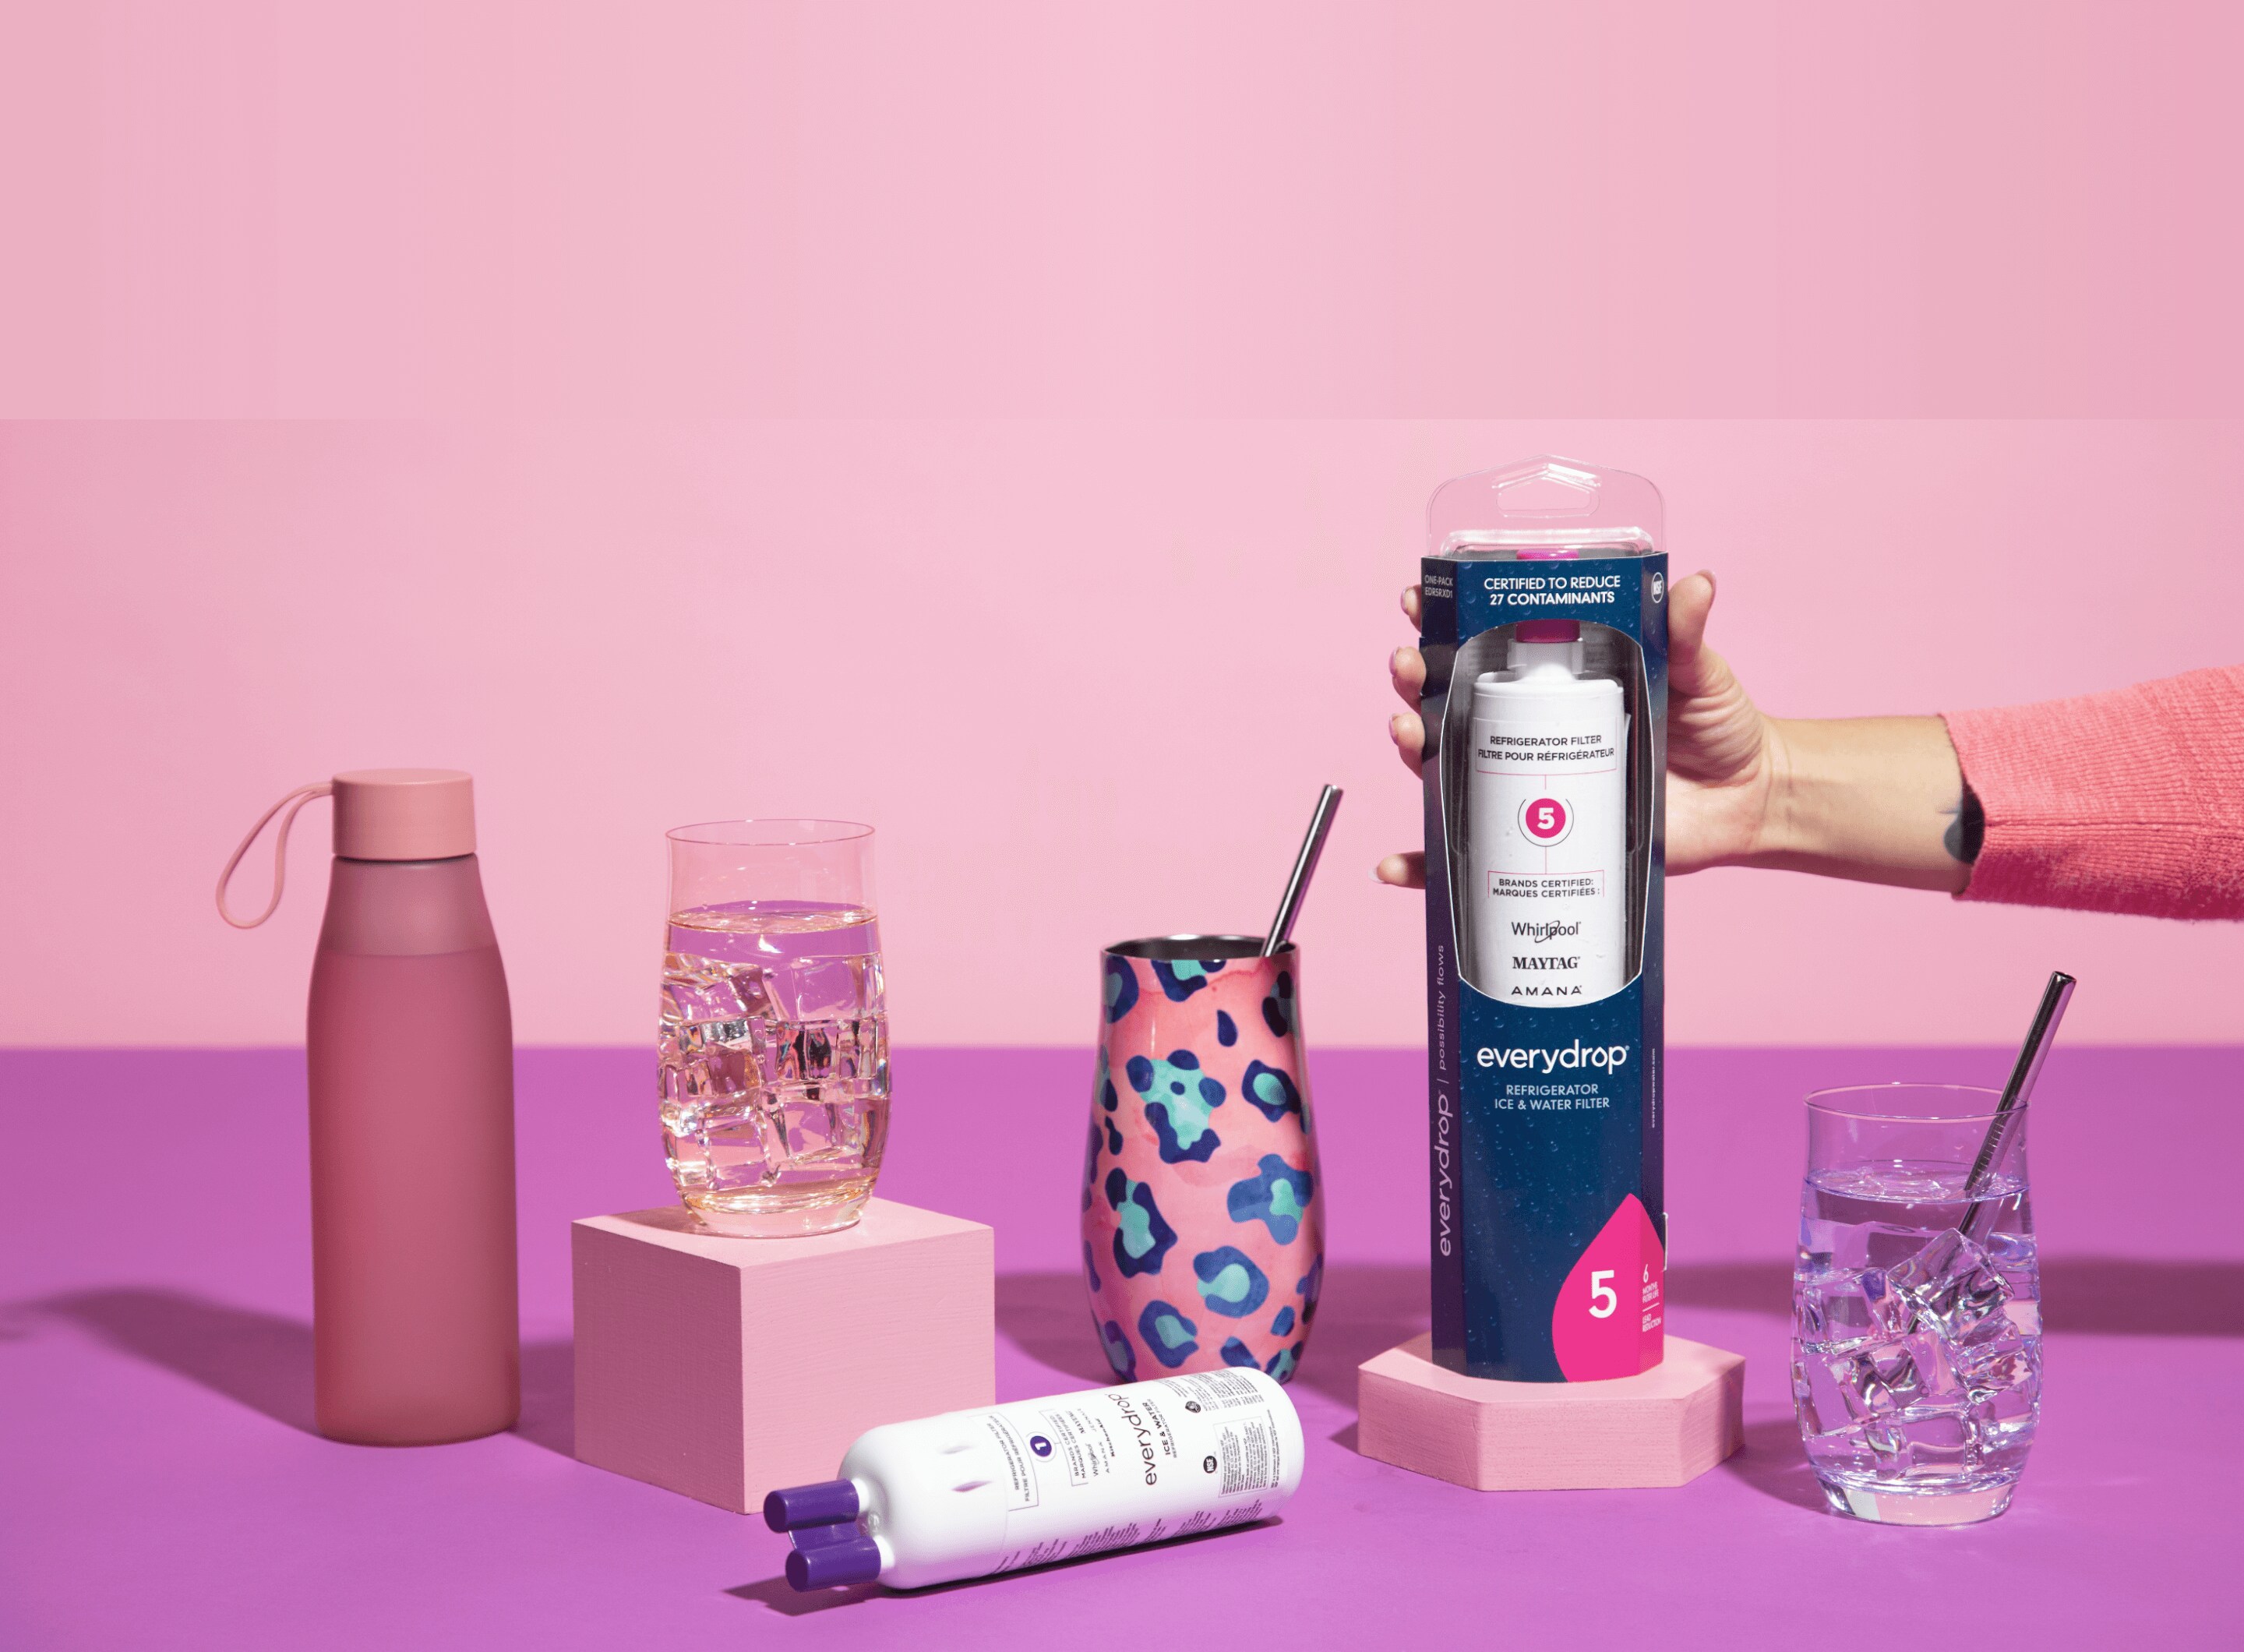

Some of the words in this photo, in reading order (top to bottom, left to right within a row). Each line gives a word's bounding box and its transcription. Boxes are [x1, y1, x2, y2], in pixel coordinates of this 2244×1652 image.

[1424, 574, 1453, 586] ONE-PACK
[1484, 577, 1546, 591] CERTIFIED
[1547, 577, 1568, 589] TO
[1570, 575, 1621, 589] REDUCE
[1424, 587, 1453, 598] EDR5RXD1
[1490, 593, 1505, 605] 27
[1507, 591, 1615, 605] CONTAMINANTS
[1490, 736, 1568, 747] REFRIGERATOR
[1570, 735, 1602, 746] FILTER
[1477, 748, 1502, 760] FILTRE
[1505, 751, 1534, 761] POUR
[1537, 747, 1614, 761] RÉFRIGÉRATEUR
[1537, 807, 1555, 830] 5
[1498, 878, 1538, 888] BRANDS
[1540, 878, 1594, 888] CERTIFIED:
[1493, 888, 1539, 898] MARQUES
[1512, 920, 1579, 943] Whirlpool
[1512, 957, 1579, 970] MAYTAG
[1511, 986, 1581, 996] AMANA
[1437, 990, 1447, 1071] possibility
[1477, 1039, 1627, 1075] everydrop
[1506, 1084, 1599, 1096] REFRIGERATOR
[1494, 1099, 1514, 1110] ICE
[1517, 1100, 1527, 1110] &
[1530, 1100, 1572, 1110] WATER
[1575, 1097, 1611, 1110] FILTER
[1434, 1093, 1454, 1257] everydrop
[1642, 1263, 1649, 1283] 6
[1588, 1269, 1618, 1318] 5
[1141, 1402, 1163, 1429] WATER
[986, 1422, 1001, 1441] FILTER
[1107, 1393, 1157, 1486] everydrop
[1159, 1414, 1177, 1458] REFRIGERATOR
[1035, 1442, 1047, 1451] 1
[1162, 1439, 1171, 1456] ICE
[999, 1440, 1020, 1491] REFRIGERATOR
[1016, 1456, 1027, 1476] POUR
[1067, 1447, 1080, 1477] BRANDS
[1074, 1445, 1086, 1478] MARQUES
[1205, 1457, 1215, 1472] NSF
